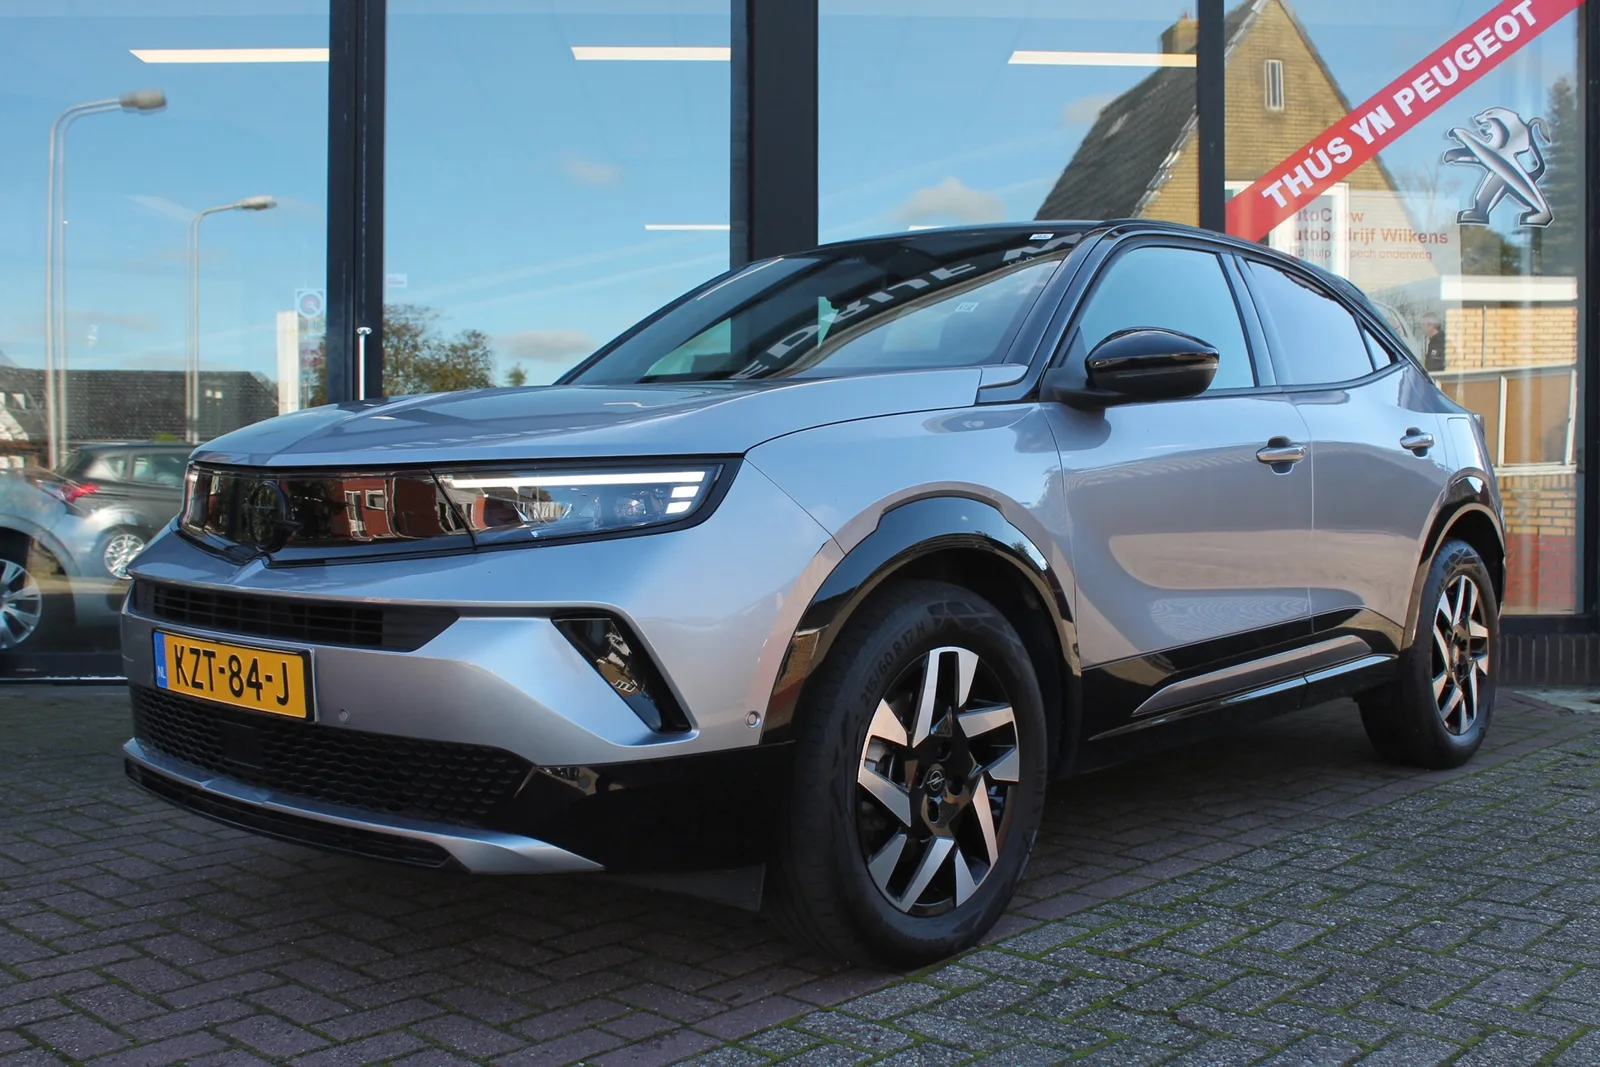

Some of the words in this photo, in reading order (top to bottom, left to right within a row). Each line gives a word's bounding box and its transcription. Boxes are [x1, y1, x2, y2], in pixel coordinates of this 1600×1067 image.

[1261, 146, 1353, 208] THÚS
[1349, 104, 1396, 145] YN
[1392, 0, 1537, 117] PEUGEOT
[1381, 227, 1449, 244] Wilkens
[157, 665, 167, 679] NL
[174, 644, 290, 706] KZT-84-J
[861, 652, 894, 707] 215/60
